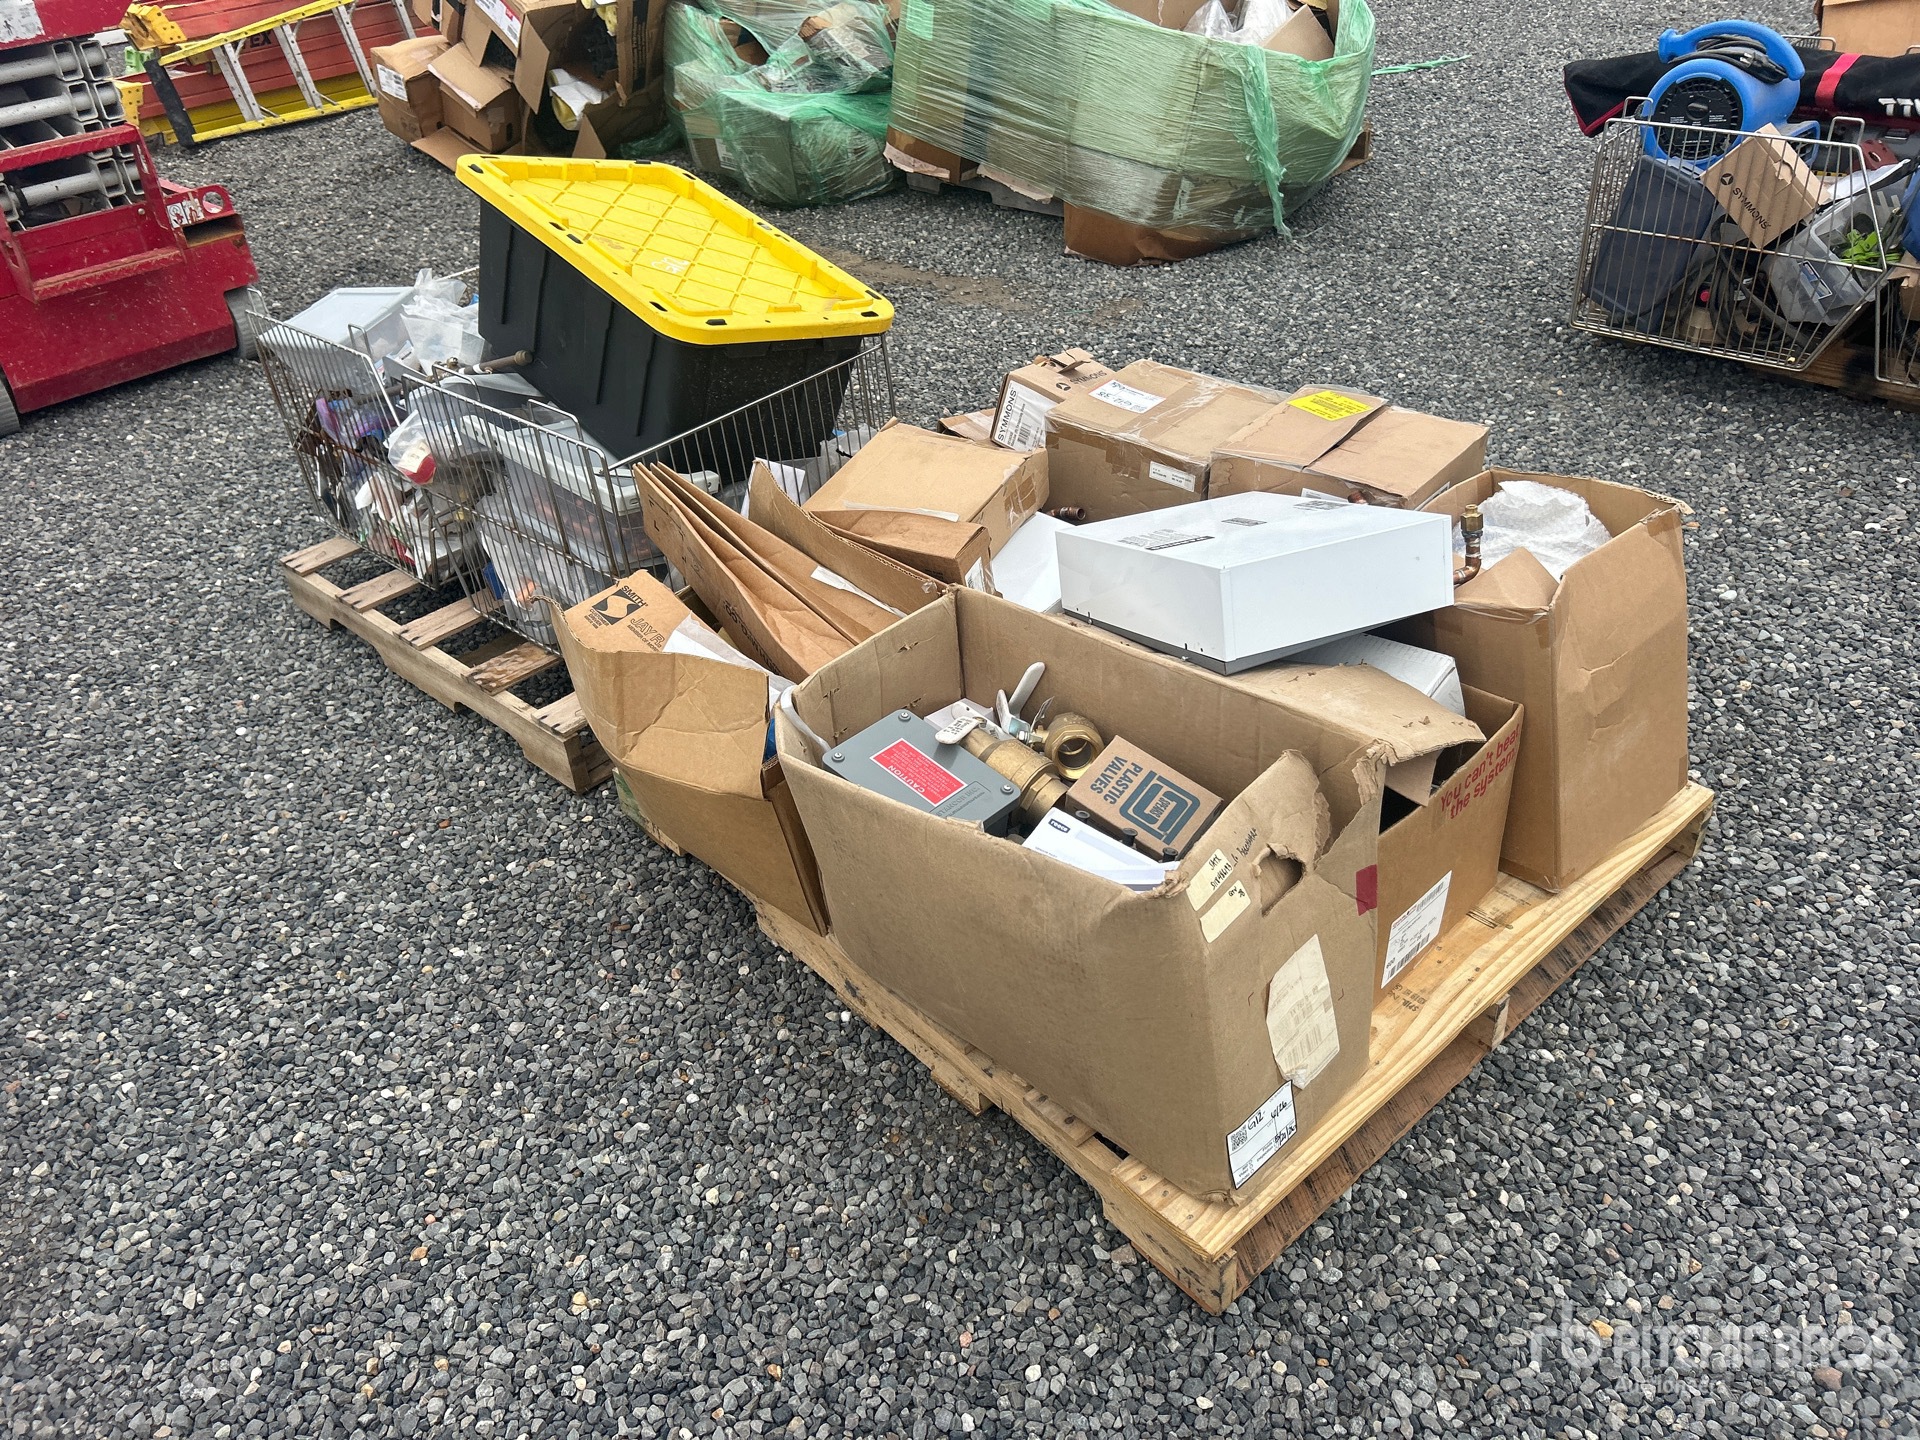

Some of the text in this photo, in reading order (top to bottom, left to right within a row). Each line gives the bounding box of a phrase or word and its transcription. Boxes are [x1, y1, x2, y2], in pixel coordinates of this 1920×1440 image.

[1732, 188, 1770, 229] SYMMONS
[1070, 370, 1107, 385] SYMMONS
[998, 388, 1017, 442] SYMMONS
[621, 586, 646, 608] SMITH
[630, 618, 656, 636] JAY
[886, 764, 926, 792] CAUTION
[1090, 756, 1128, 795] VALVES
[1104, 762, 1143, 805] PLASTIC
[1440, 783, 1461, 812] You
[1464, 751, 1493, 790] can't
[1450, 793, 1471, 820] the
[1050, 820, 1068, 832] reece
